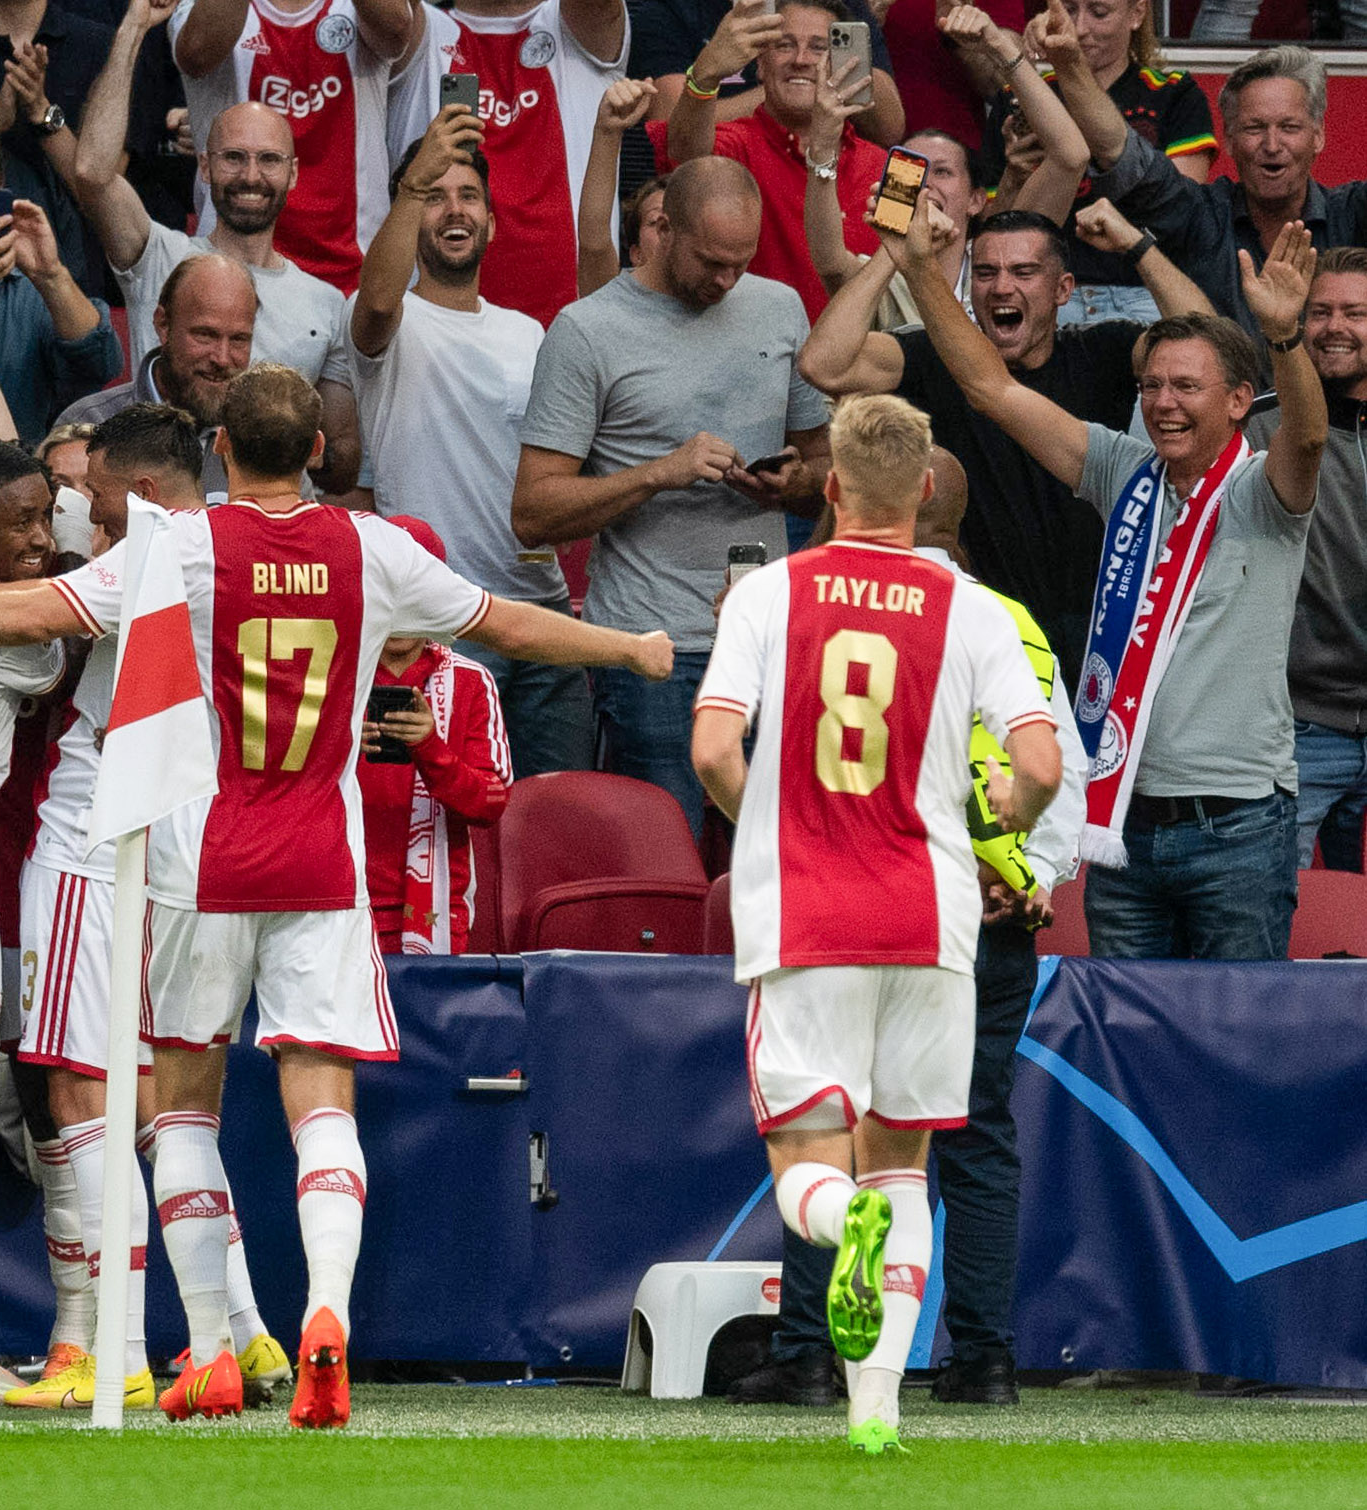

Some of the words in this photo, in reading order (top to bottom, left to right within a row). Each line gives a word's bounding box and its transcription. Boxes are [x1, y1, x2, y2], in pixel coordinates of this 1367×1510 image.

[252, 562, 329, 595] BLIND
[814, 574, 925, 617] TAYLOR
[1117, 558, 1136, 600] IBROX
[237, 618, 339, 772] 17
[815, 628, 899, 797] 8
[22, 950, 38, 1012] 3
[306, 1178, 360, 1200] adidas
[170, 1204, 225, 1219] adidas
